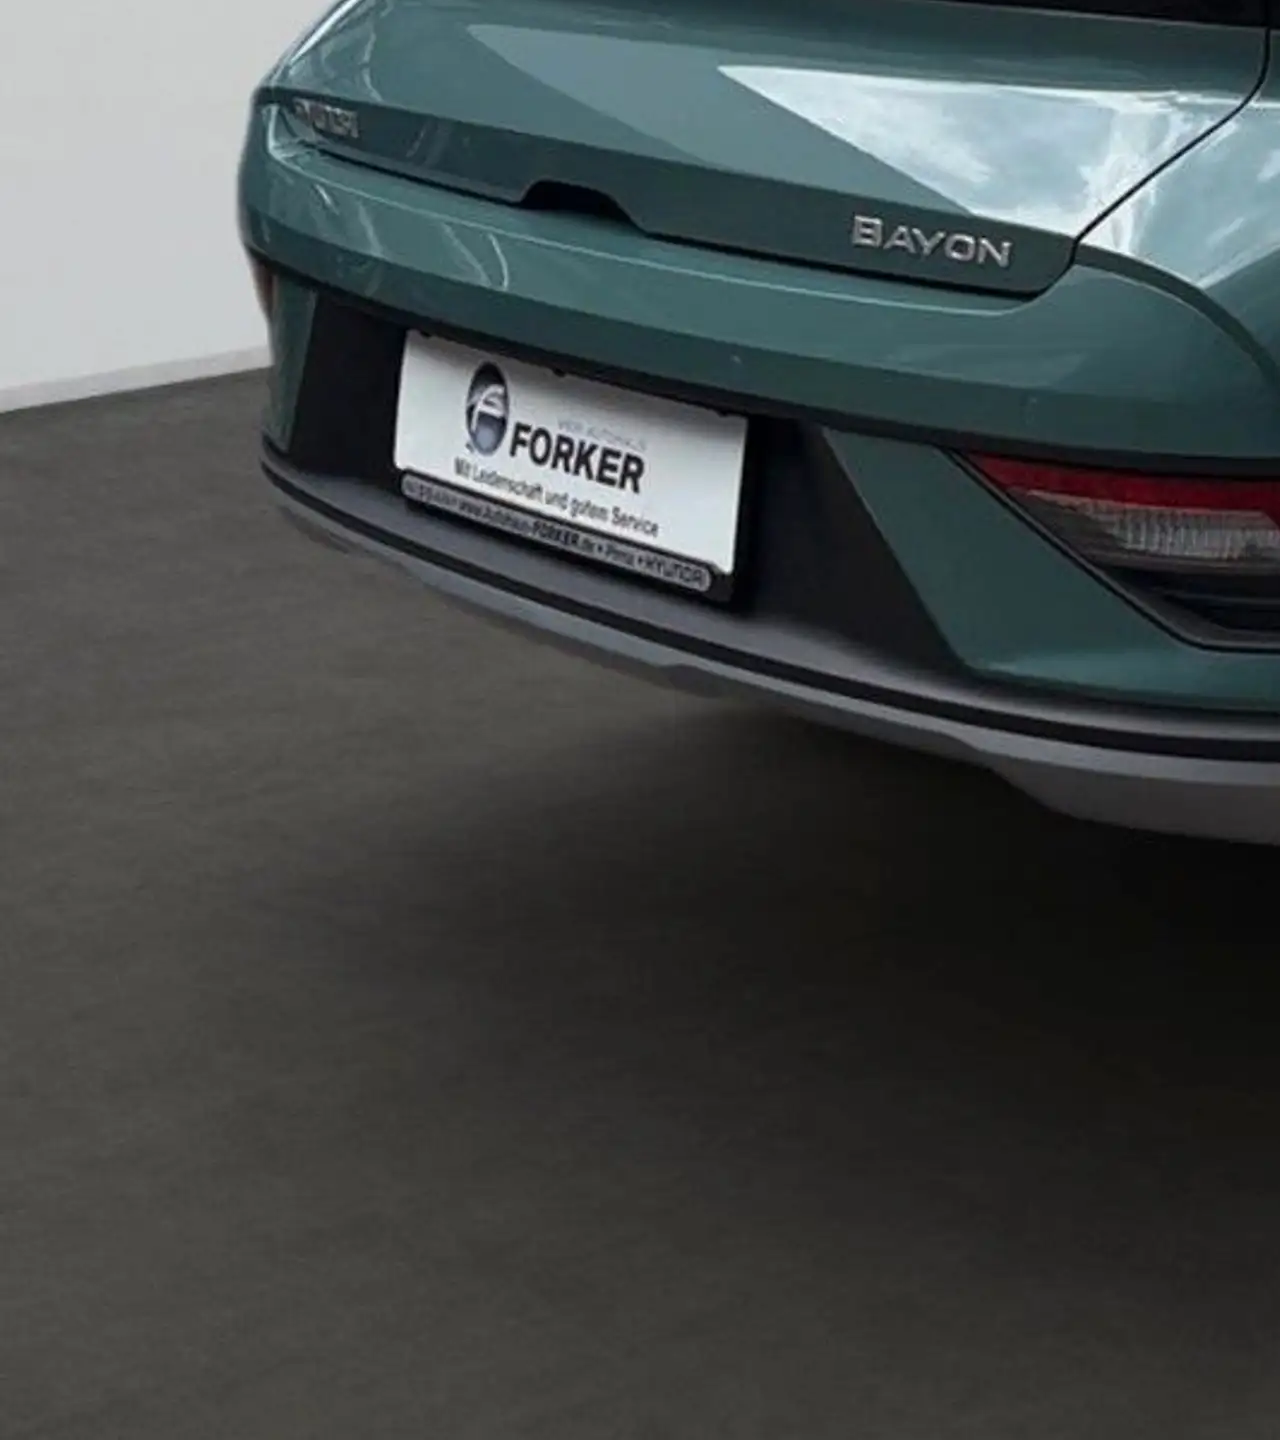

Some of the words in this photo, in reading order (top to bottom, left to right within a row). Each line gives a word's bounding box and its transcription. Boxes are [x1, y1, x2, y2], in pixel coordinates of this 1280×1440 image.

[852, 215, 1013, 268] BAYON
[510, 422, 645, 494] FORKER
[545, 493, 570, 511] und
[571, 496, 609, 522] gutem
[611, 506, 659, 538] Service
